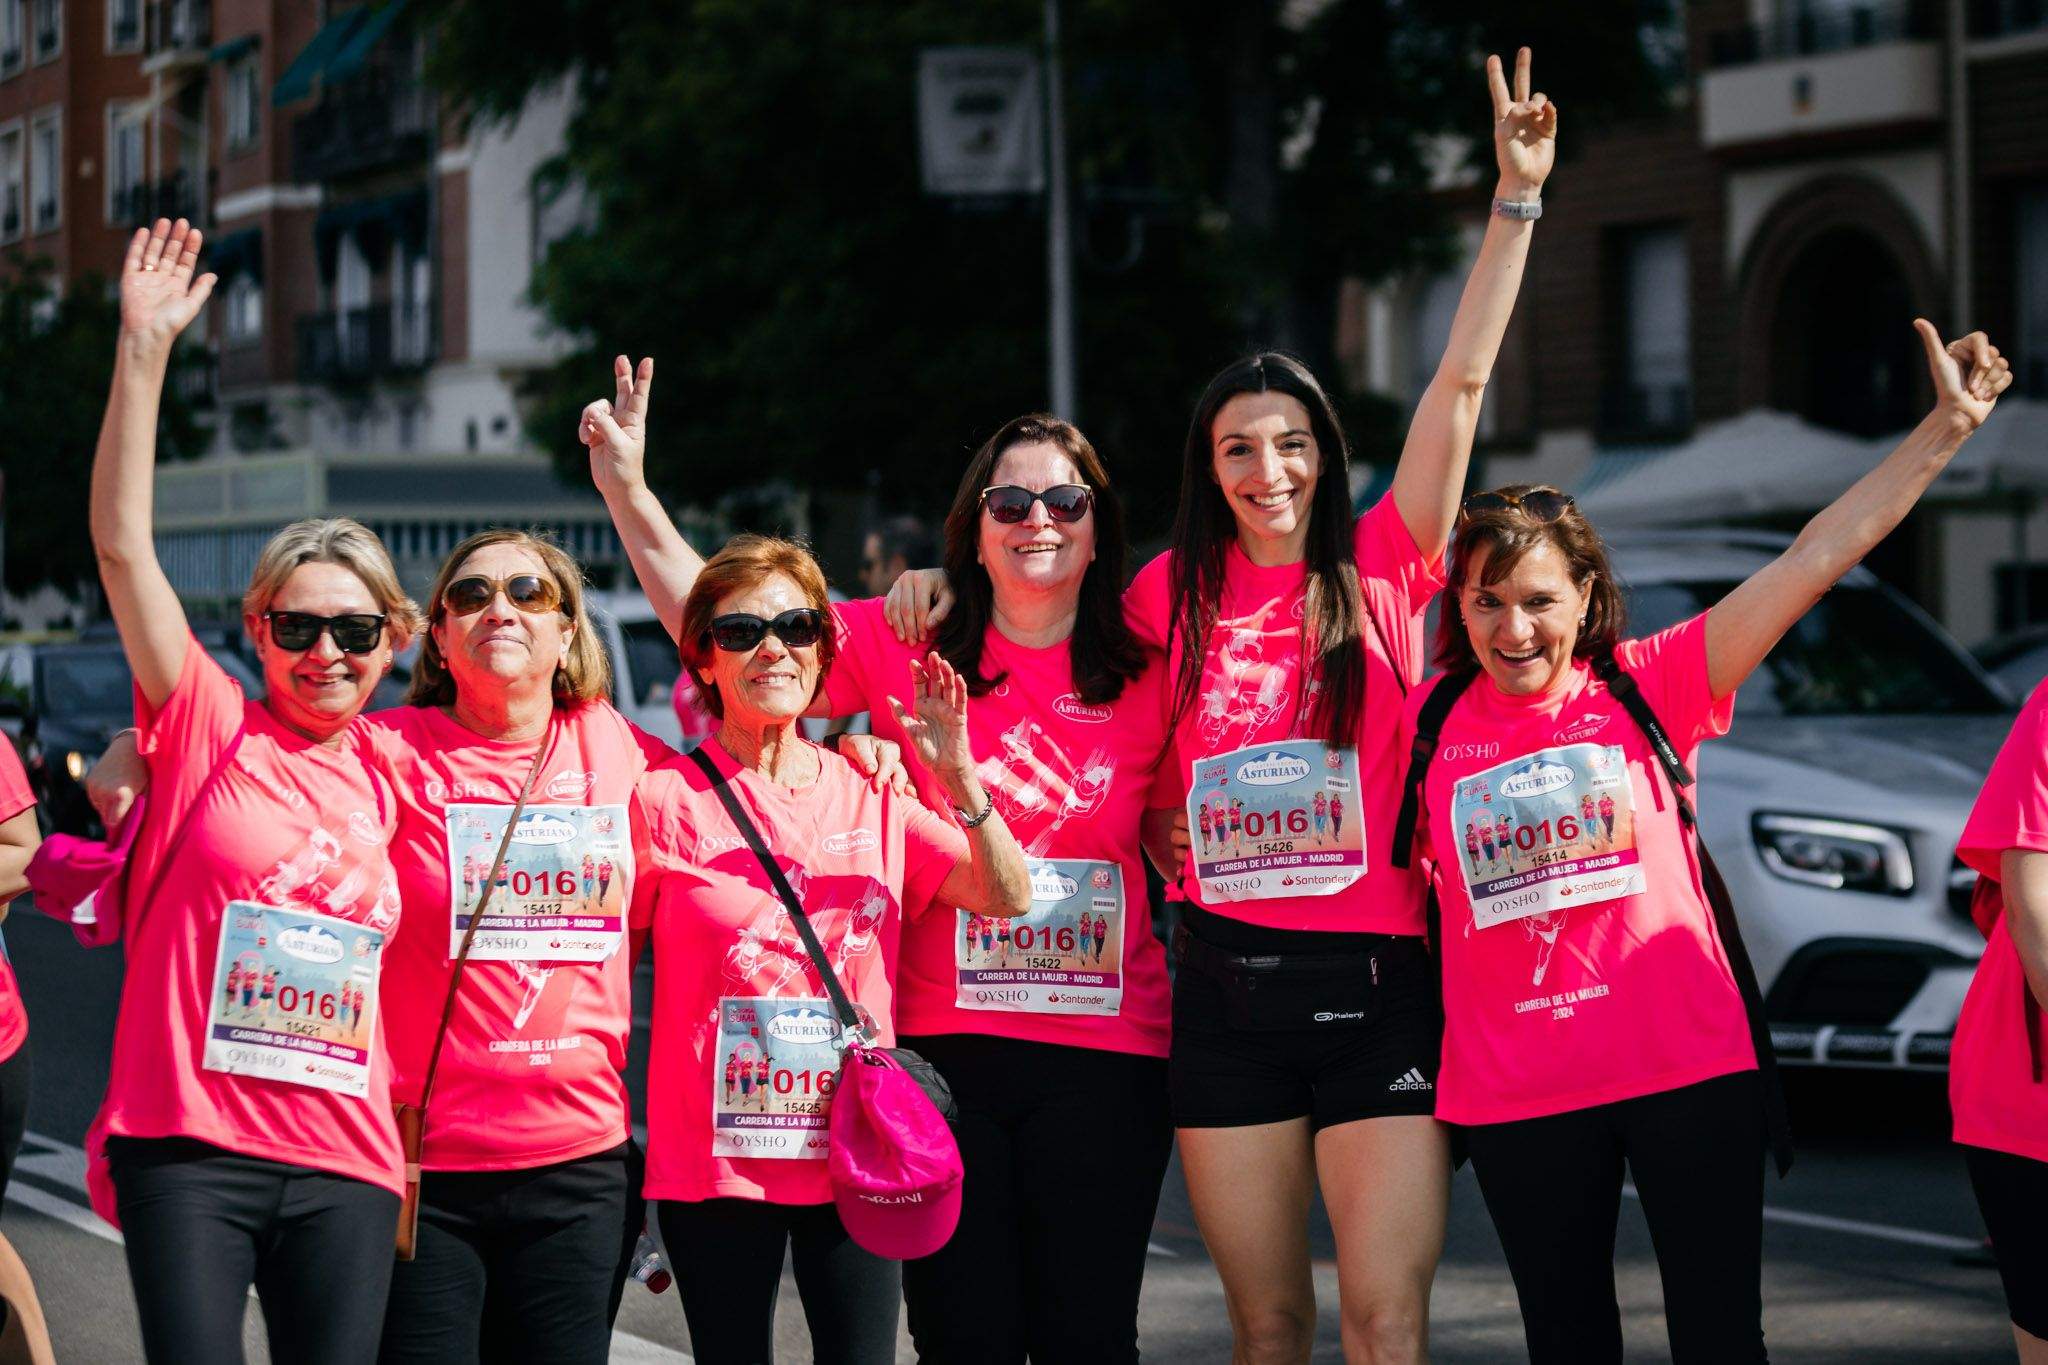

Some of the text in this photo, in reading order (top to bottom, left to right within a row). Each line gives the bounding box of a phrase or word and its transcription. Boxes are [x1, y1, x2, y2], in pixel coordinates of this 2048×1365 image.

[1057, 701, 1108, 719] ASTURIANA
[1444, 742, 1499, 761] OYSHO
[1240, 766, 1306, 780] ASTURIANA
[1506, 773, 1571, 794] ASTURIANA
[1245, 808, 1309, 837] 016
[1515, 815, 1579, 851] 016
[1257, 841, 1293, 855] 15426
[1214, 860, 1248, 873] CARRERA
[1250, 858, 1260, 868] DE
[1261, 856, 1272, 866] LA
[1273, 856, 1302, 866] MUJER
[1309, 854, 1344, 863] MADRID
[1531, 850, 1568, 868] 15414
[1094, 871, 1109, 882] 20
[1295, 873, 1347, 887] Santander
[1488, 878, 1525, 893] CARRERA
[1526, 873, 1536, 883] DE
[1537, 870, 1547, 880] LA
[1548, 864, 1578, 877] MUJER
[1586, 855, 1620, 869] MADRID
[512, 870, 576, 895] 016
[1214, 877, 1261, 893] OYSHO
[1574, 877, 1626, 895] Santander
[523, 903, 562, 915] 15412
[1492, 891, 1540, 914] OYSHO
[479, 918, 513, 927] ARRERA
[527, 919, 539, 928] LA
[1014, 925, 1075, 951] 016
[1025, 957, 1061, 969] 15422
[977, 972, 1014, 981] CARRERA
[1017, 972, 1028, 981] DE
[1029, 972, 1040, 981] LA
[1042, 973, 1068, 982] MUJER
[1074, 975, 1103, 984] MADRID
[278, 985, 335, 1020] 016
[976, 989, 1029, 1003] OYSHO
[1061, 993, 1105, 1005] Santander
[1515, 985, 1610, 1013] CARRERA DE LA MUJER
[1552, 1006, 1575, 1020] 2024
[286, 1021, 321, 1038] 15421
[772, 1021, 836, 1037] ASTURIANA
[774, 1069, 836, 1095] 016
[1389, 1081, 1433, 1091] adidas
[784, 1103, 821, 1114] 15425
[734, 1116, 827, 1126] CARRERA DE LA MUJER
[733, 1134, 787, 1148] OYSHO
